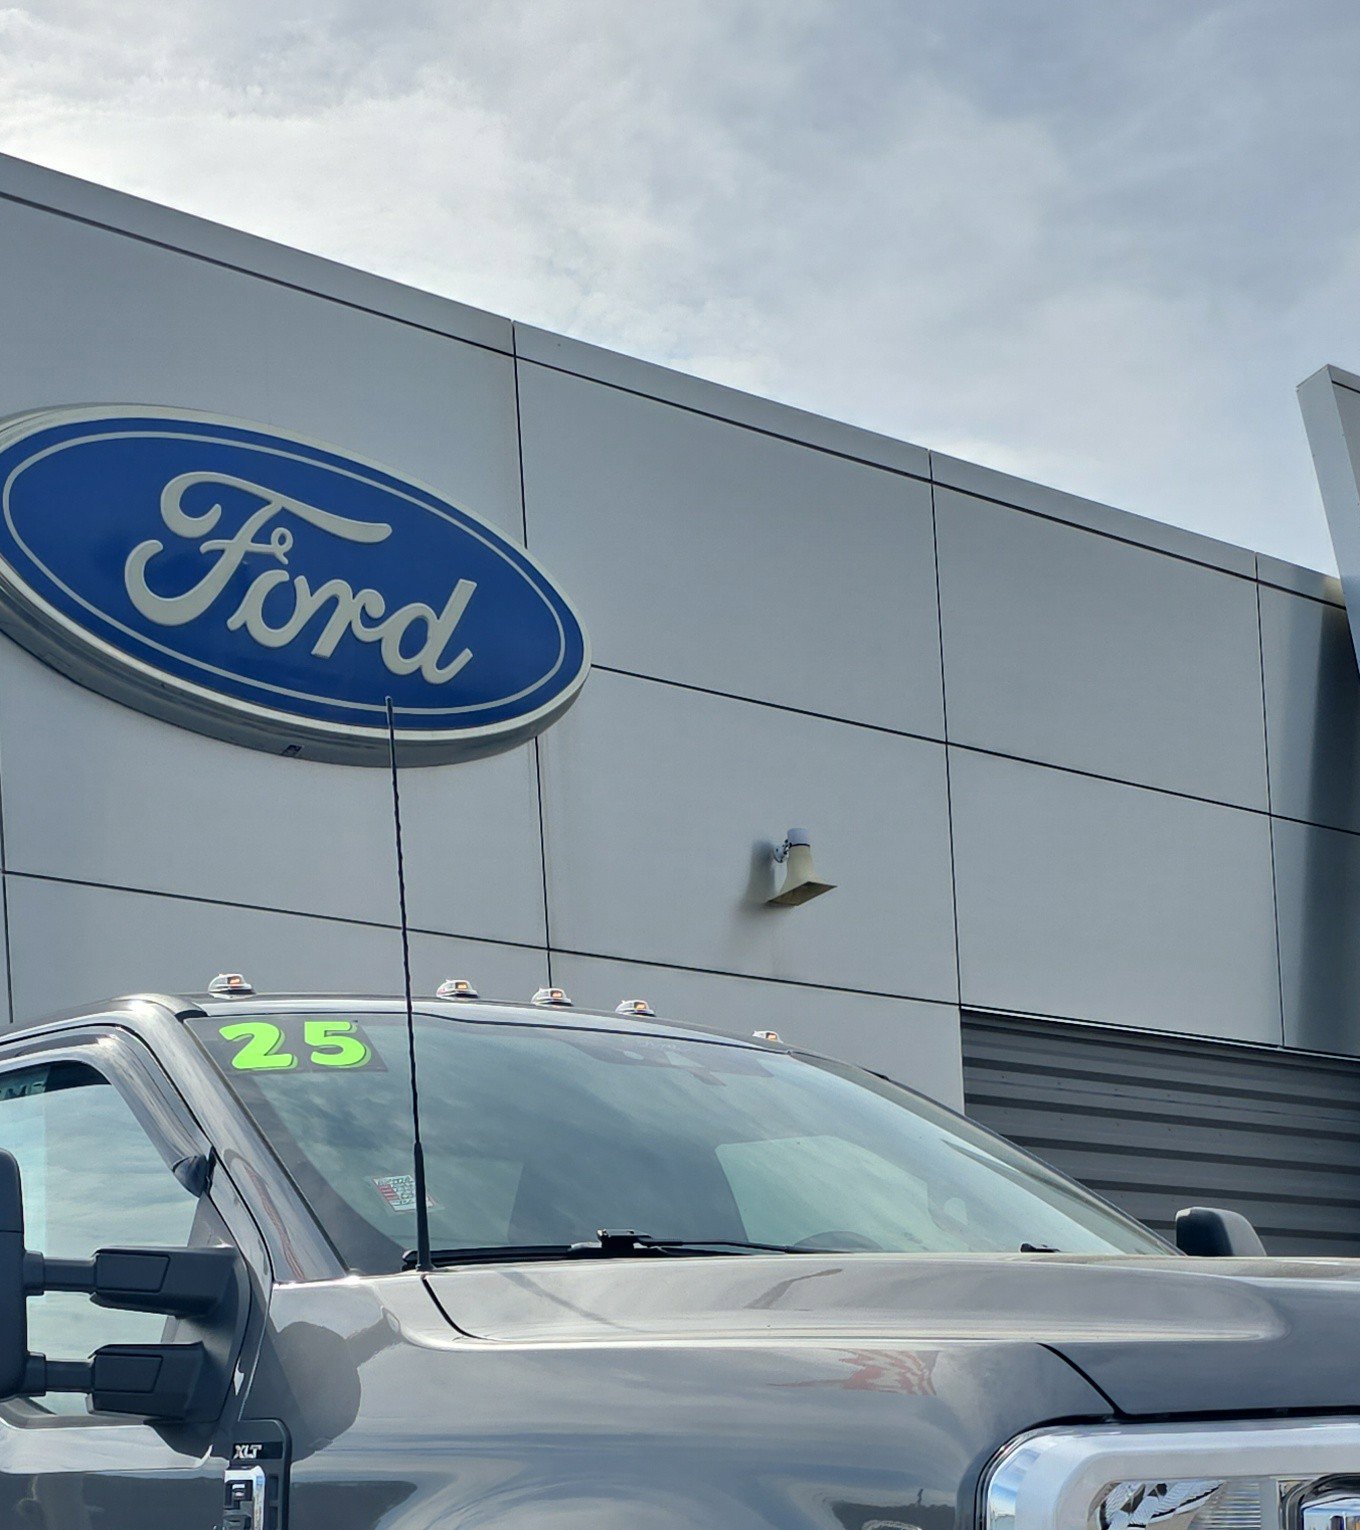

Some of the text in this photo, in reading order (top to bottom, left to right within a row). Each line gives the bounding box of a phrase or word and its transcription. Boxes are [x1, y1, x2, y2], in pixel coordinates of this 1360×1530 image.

[125, 470, 477, 684] Ford
[218, 1020, 373, 1071] 25
[232, 1443, 263, 1460] XLT
